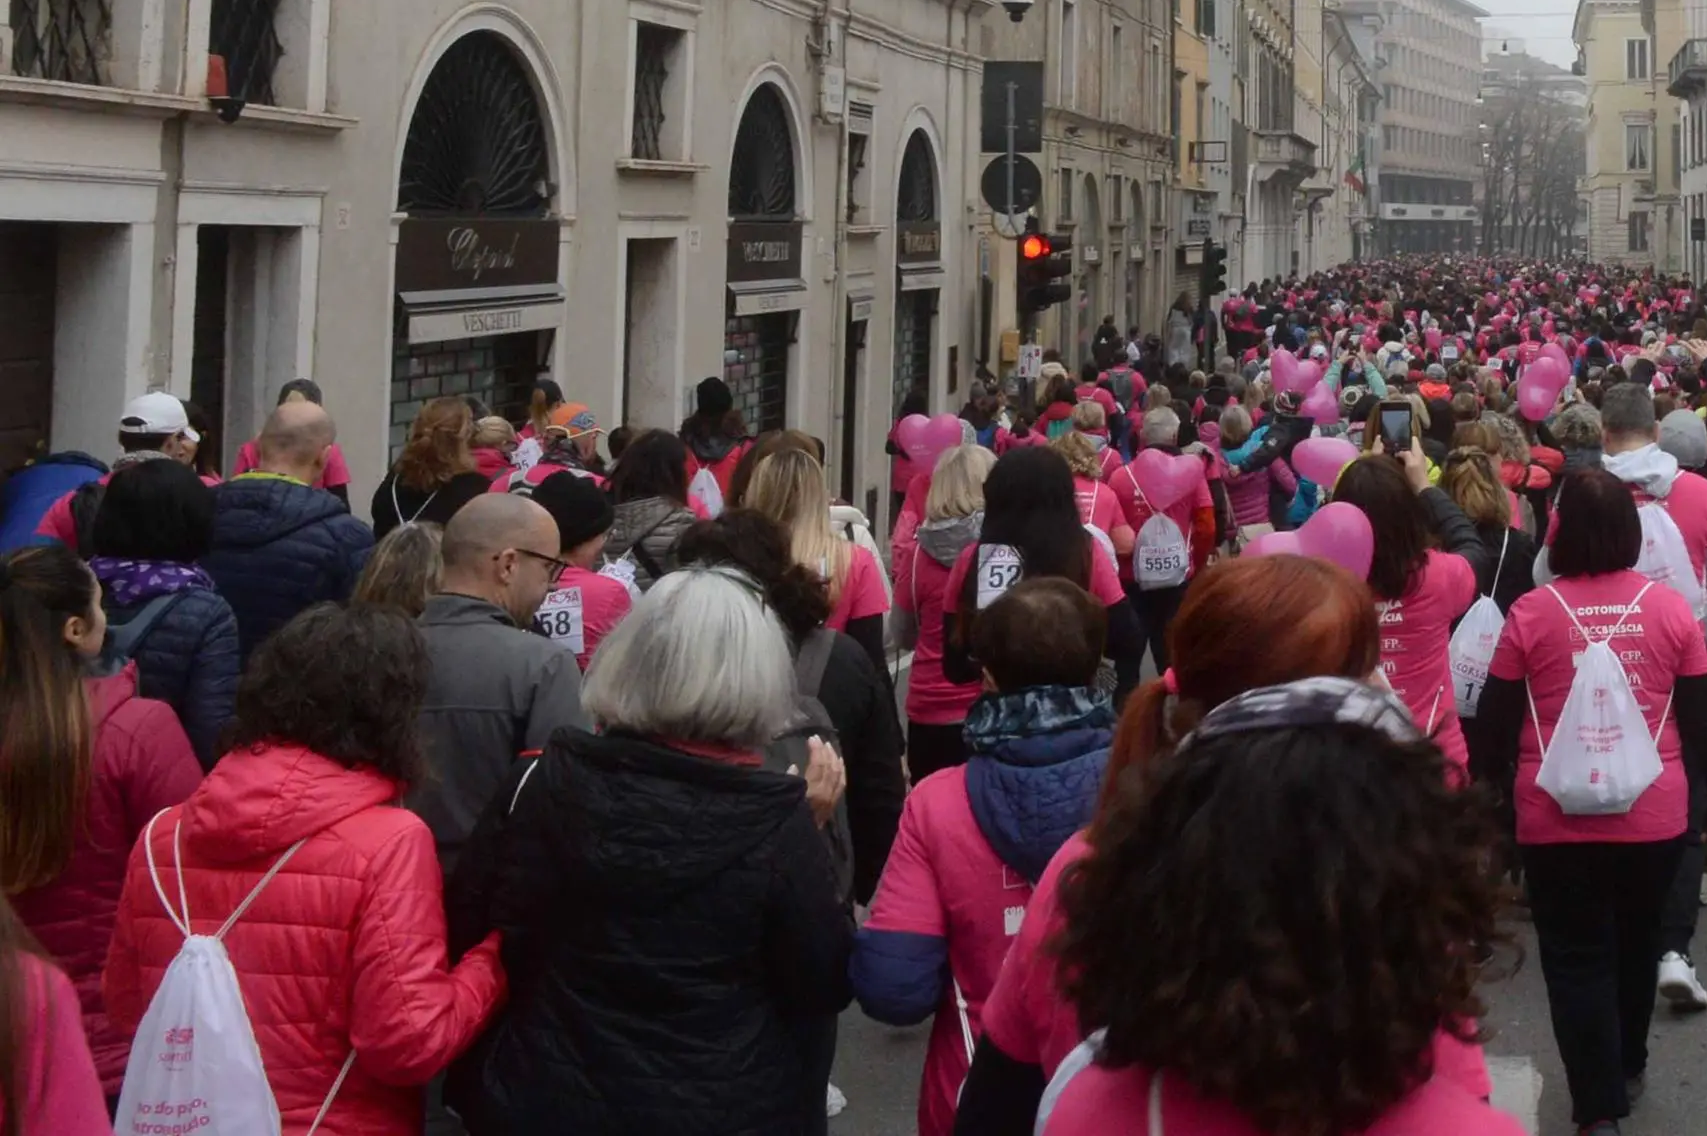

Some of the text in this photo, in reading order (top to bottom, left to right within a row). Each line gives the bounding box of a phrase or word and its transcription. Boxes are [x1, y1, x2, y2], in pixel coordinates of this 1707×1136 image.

[463, 311, 522, 332] VESCHETTI
[1145, 554, 1181, 571] 5553
[1577, 605, 1642, 616] COTONELLA
